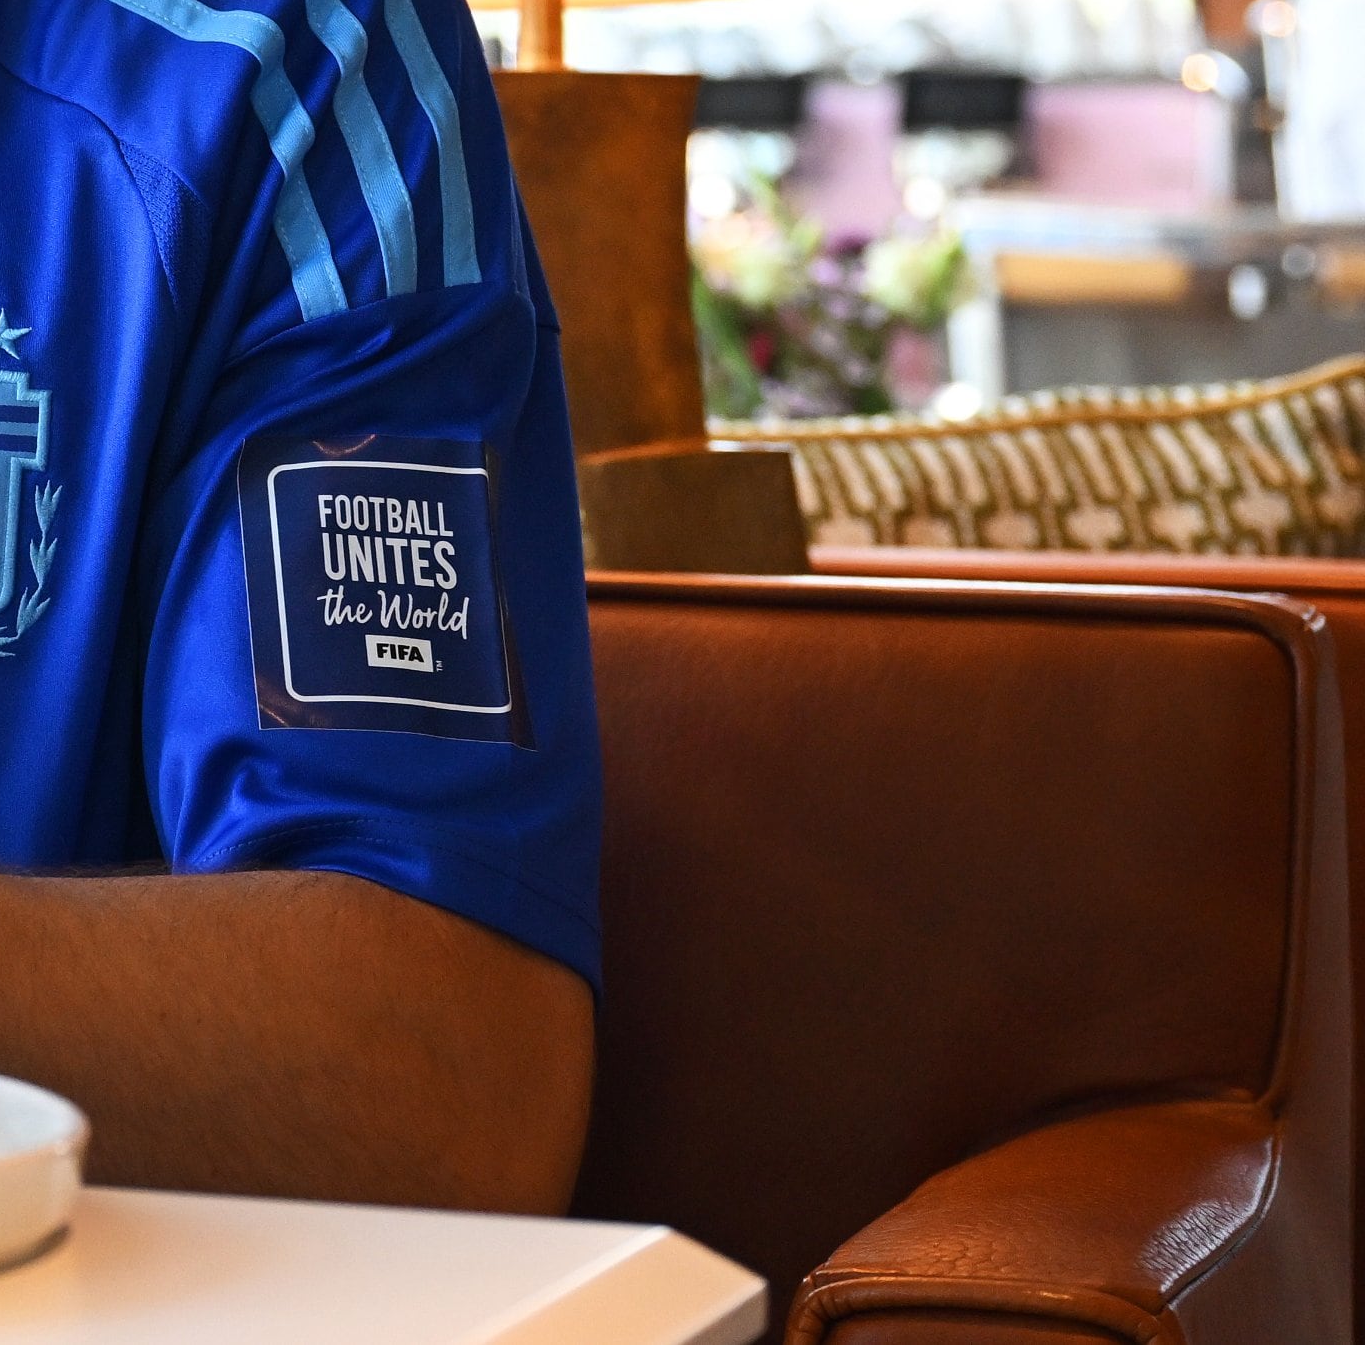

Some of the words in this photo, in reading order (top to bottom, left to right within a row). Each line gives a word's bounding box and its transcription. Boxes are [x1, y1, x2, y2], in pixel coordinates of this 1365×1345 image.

[317, 494, 453, 537] FOOTBALL
[322, 532, 457, 590] UNITES
[316, 585, 373, 627] the
[377, 589, 470, 640] World
[376, 642, 424, 664] FIFA
